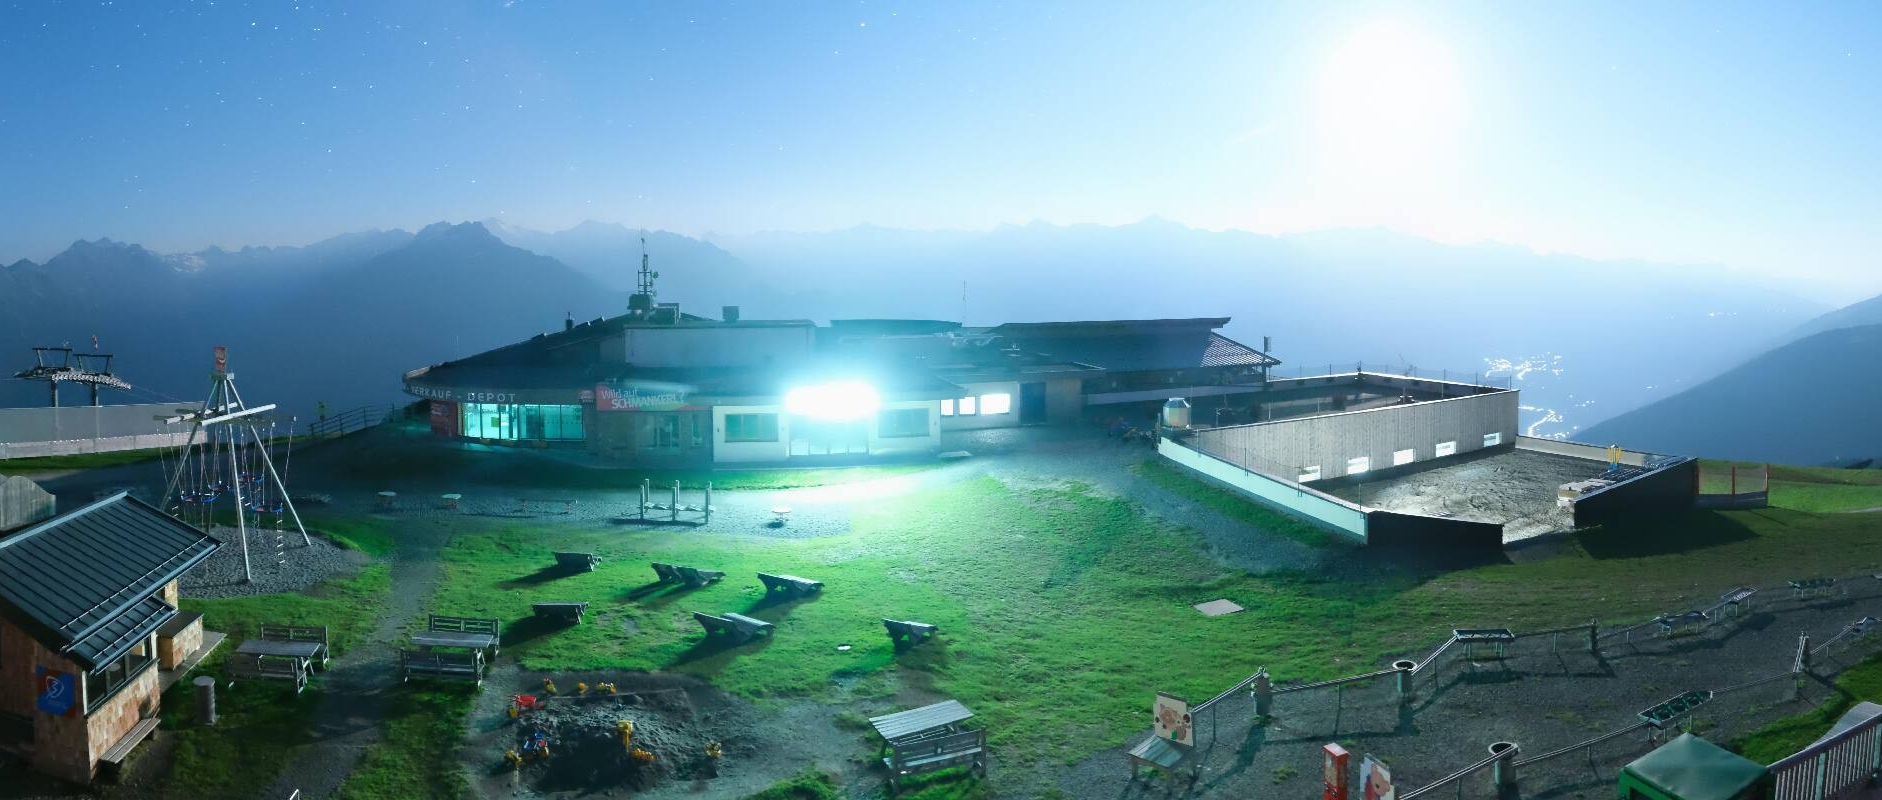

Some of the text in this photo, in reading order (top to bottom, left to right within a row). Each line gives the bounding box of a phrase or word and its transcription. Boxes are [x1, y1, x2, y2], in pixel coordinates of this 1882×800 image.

[411, 386, 452, 400] VERKAUF
[467, 392, 516, 402] DEPOT
[601, 389, 622, 399] Wild
